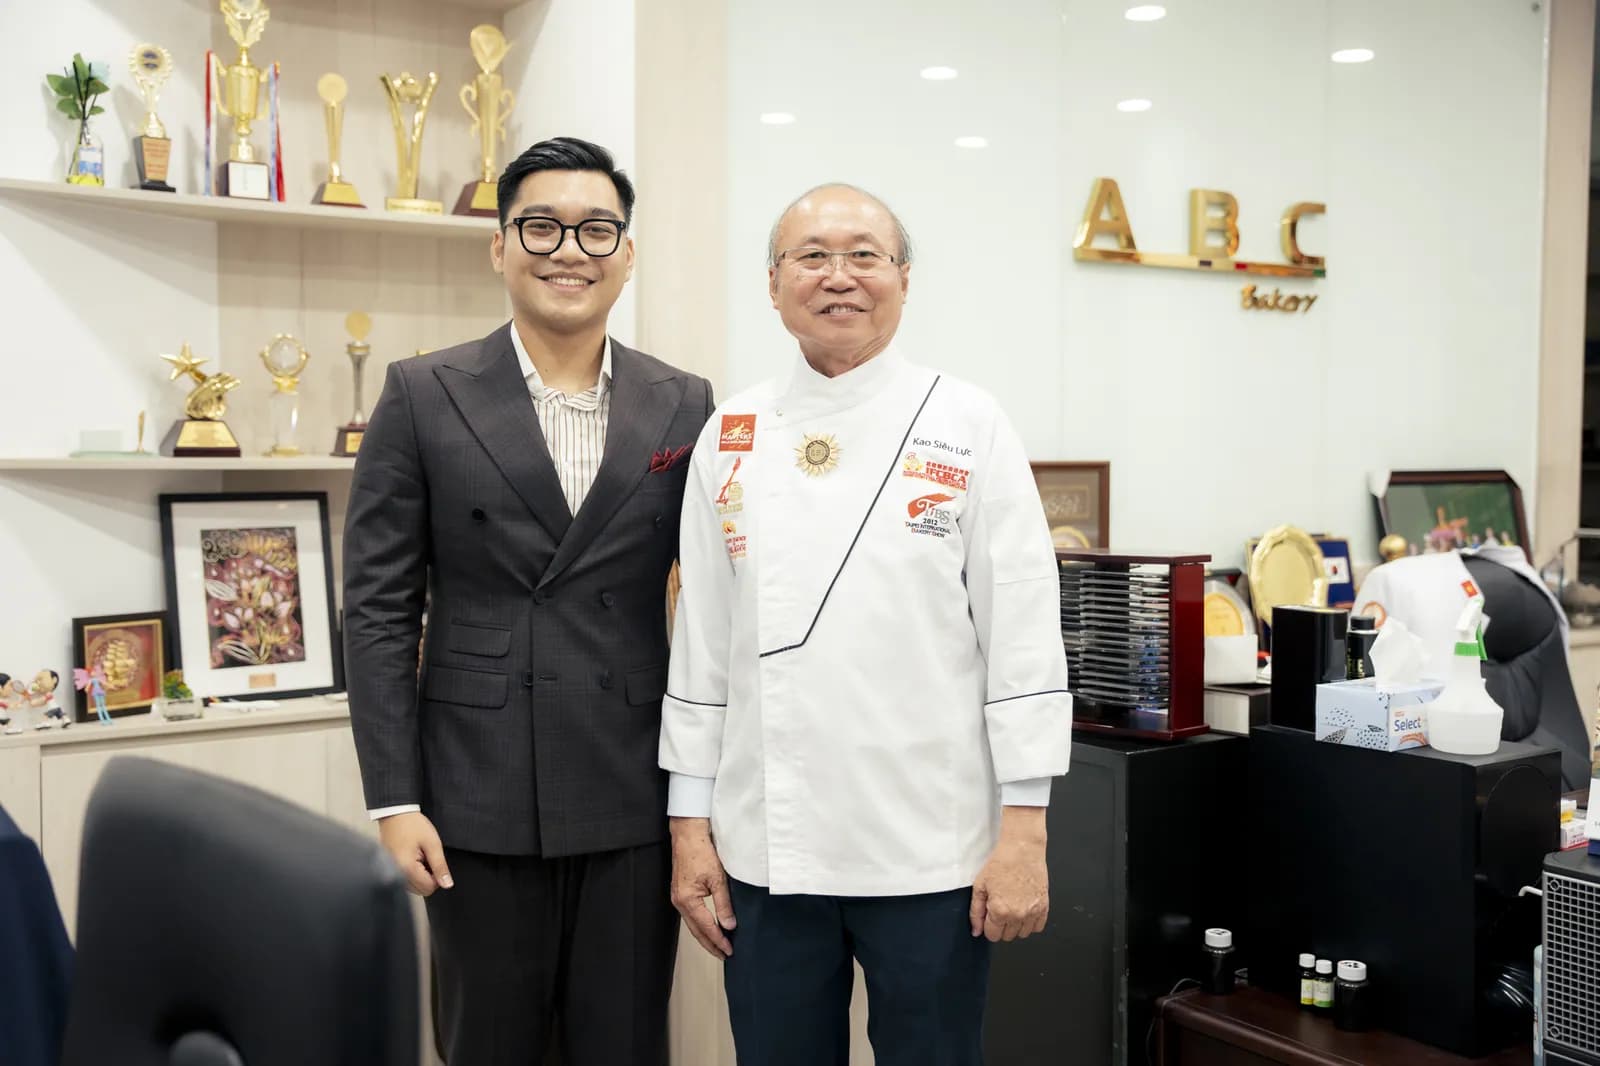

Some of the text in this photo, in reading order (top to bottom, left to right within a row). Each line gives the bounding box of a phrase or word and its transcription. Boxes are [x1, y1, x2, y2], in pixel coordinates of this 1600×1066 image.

[912, 437, 931, 447] Kao
[923, 518, 938, 526] 2012
[1394, 718, 1422, 732] Select
